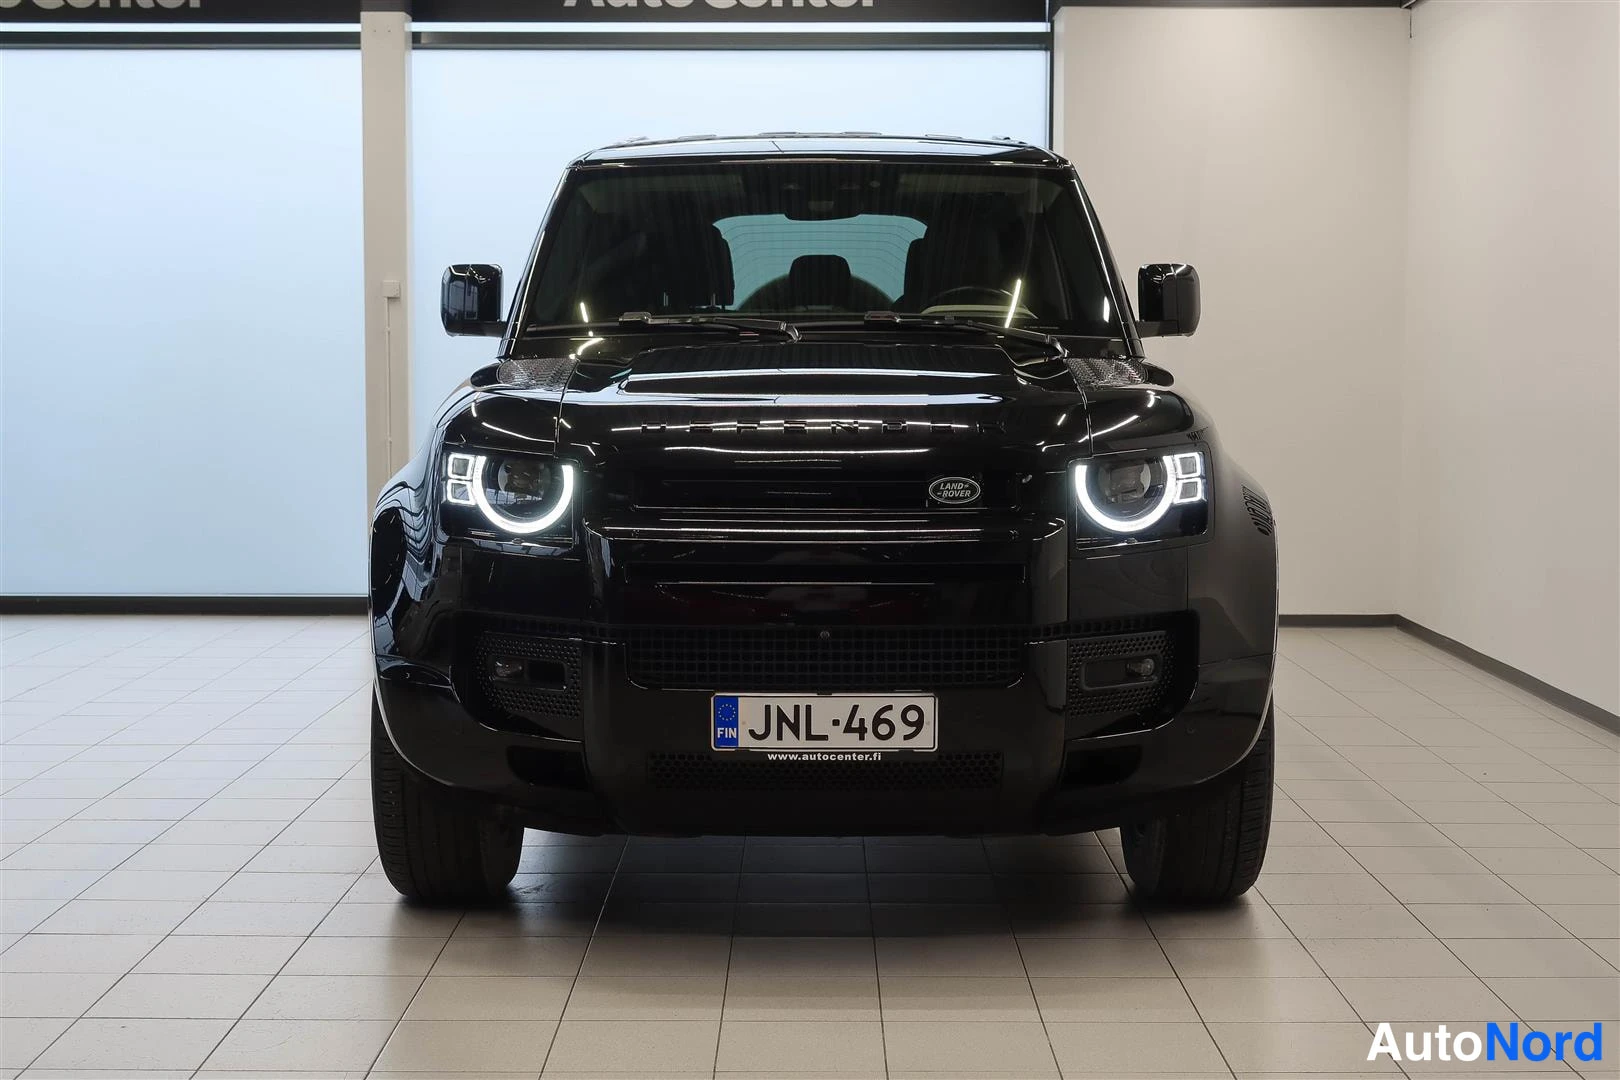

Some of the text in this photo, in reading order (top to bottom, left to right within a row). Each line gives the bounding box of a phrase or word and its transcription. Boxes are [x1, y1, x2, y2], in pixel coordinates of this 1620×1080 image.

[940, 482, 964, 490] LAND
[717, 727, 737, 739] FIN
[767, 752, 882, 761] www.autocenter.fi
